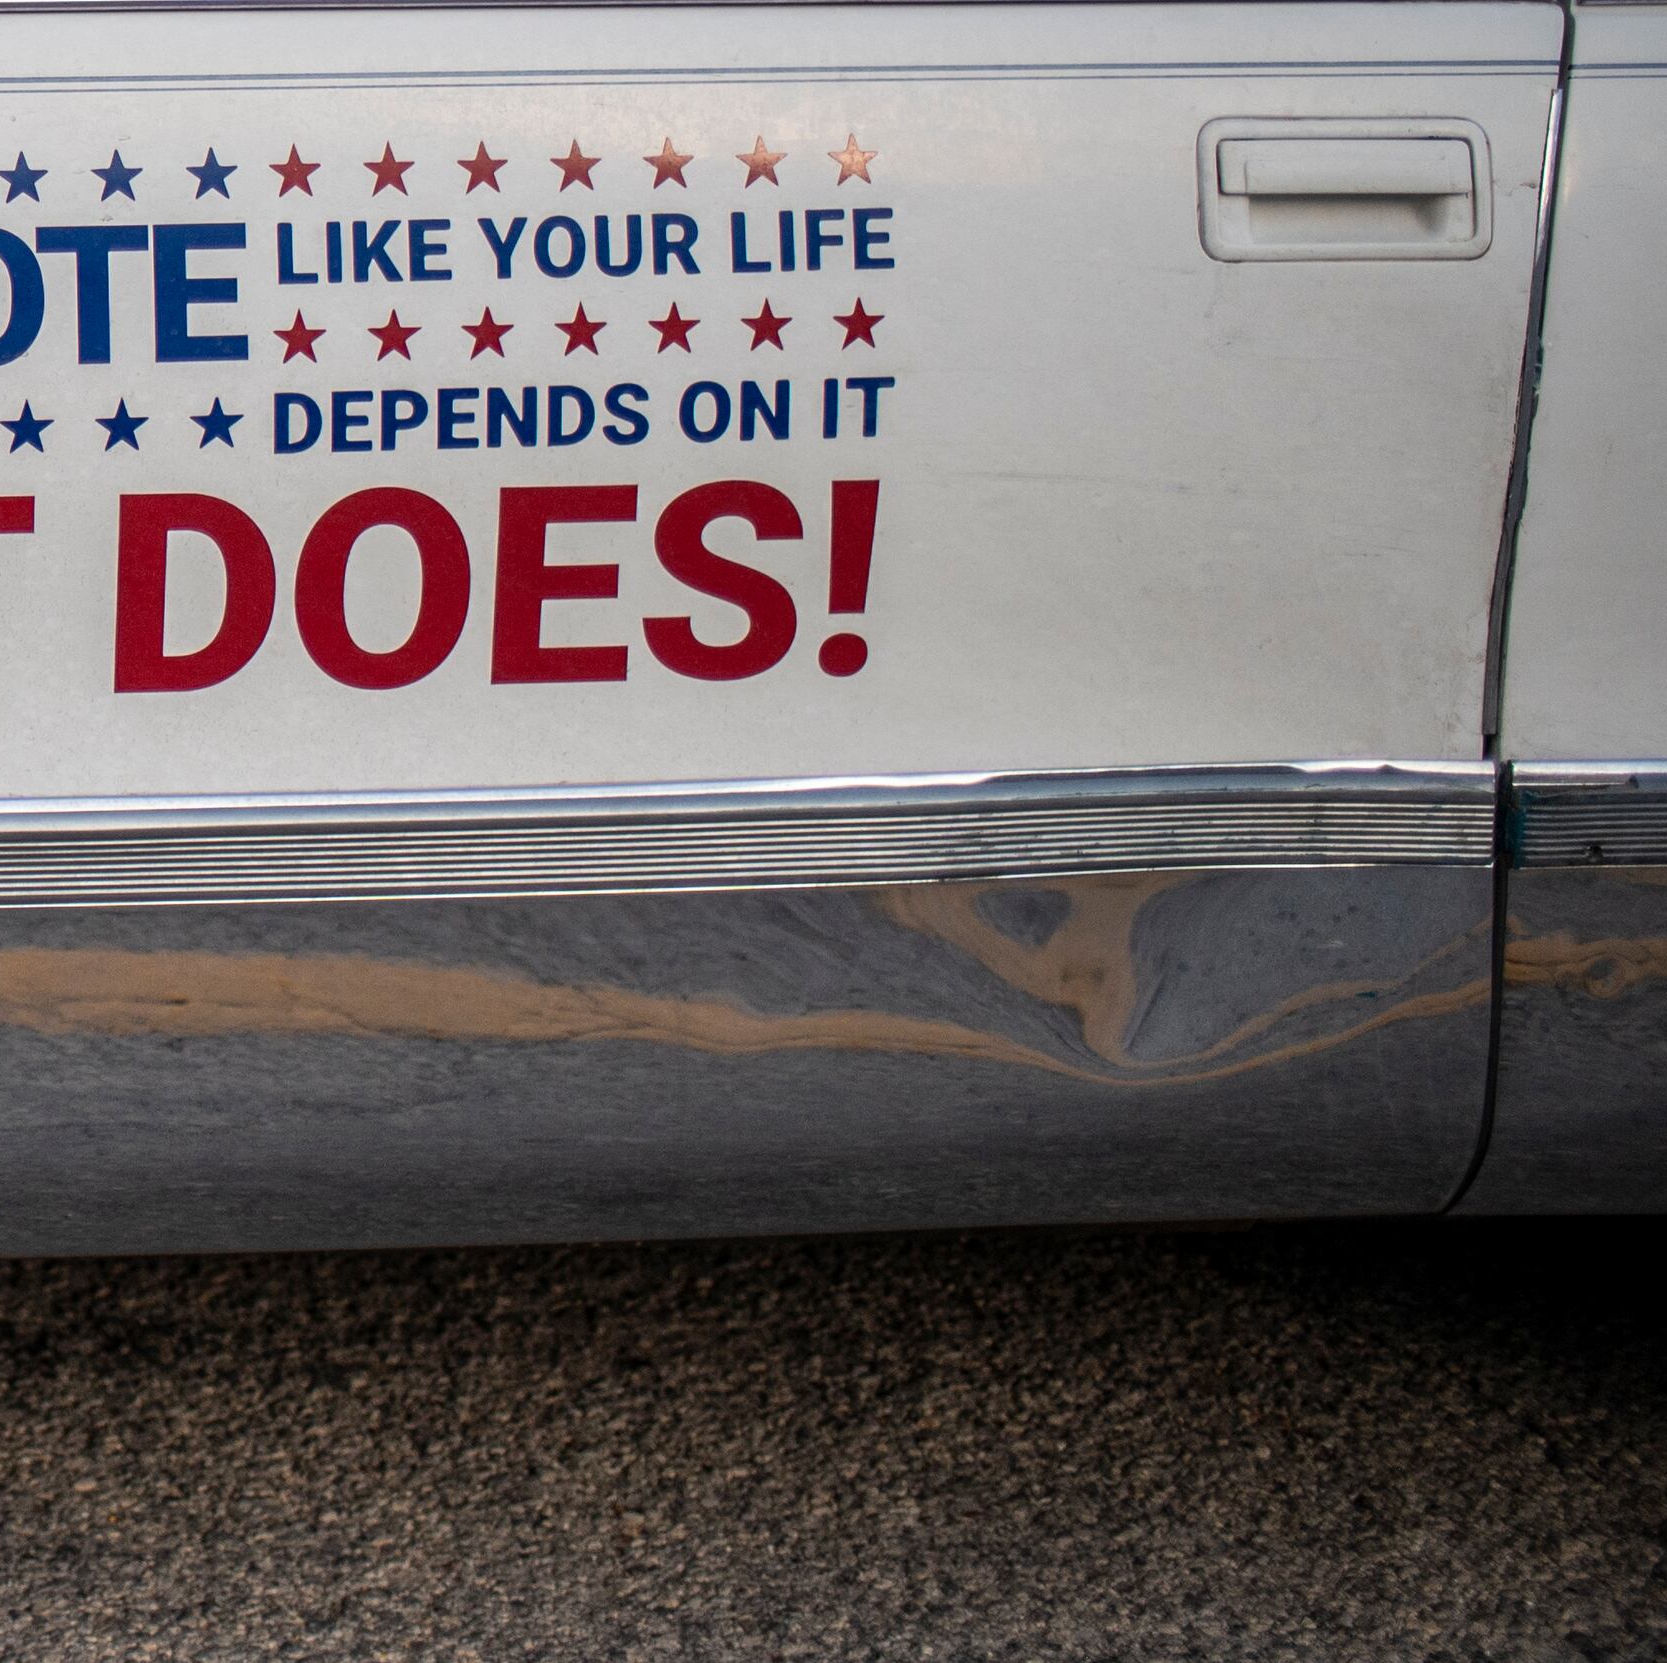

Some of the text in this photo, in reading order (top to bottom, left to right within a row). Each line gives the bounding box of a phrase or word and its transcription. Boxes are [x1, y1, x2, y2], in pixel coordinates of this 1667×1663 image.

[278, 208, 896, 285] LIKE YOUR LIFE
[274, 376, 896, 455] DEPENDS ON IT
[114, 480, 880, 692] DOES!
